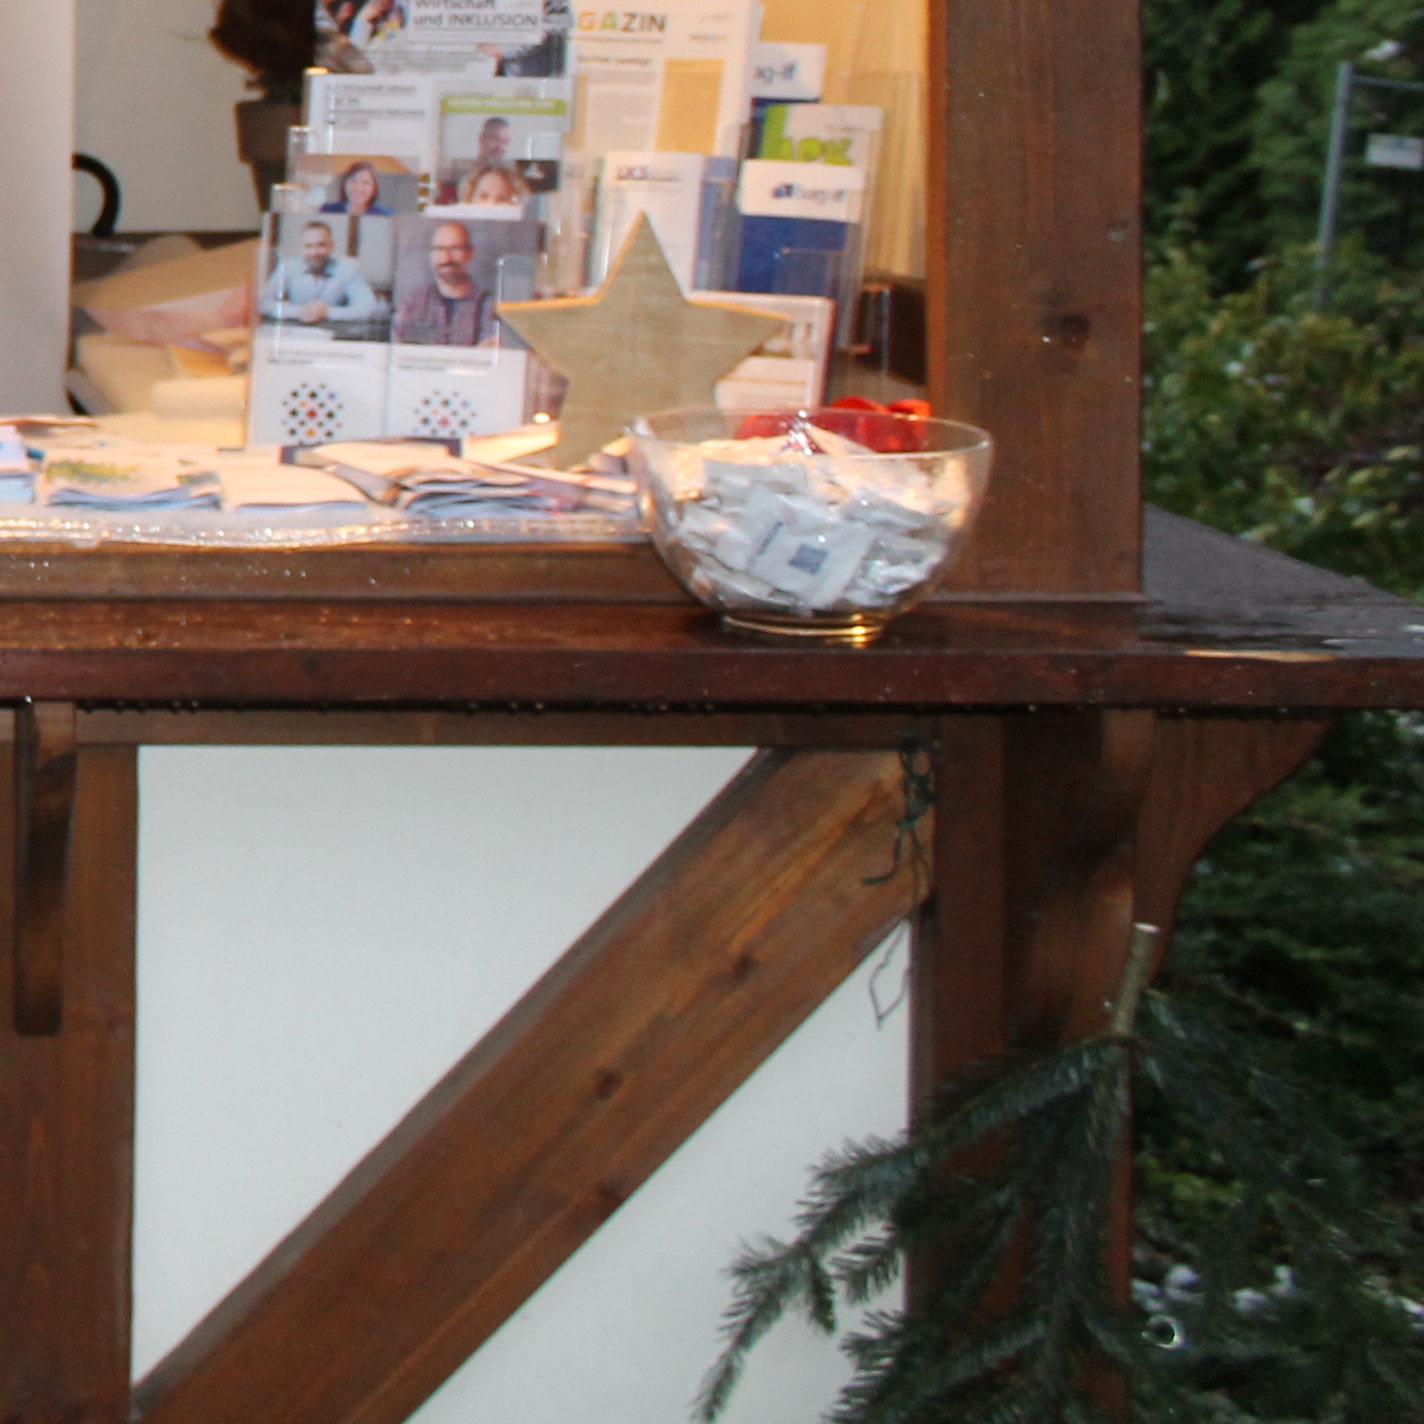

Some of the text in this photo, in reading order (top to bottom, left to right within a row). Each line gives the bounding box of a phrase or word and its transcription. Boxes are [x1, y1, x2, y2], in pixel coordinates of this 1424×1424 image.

[413, 13, 538, 27] und INKLUSION
[577, 11, 668, 33] GAZIN
